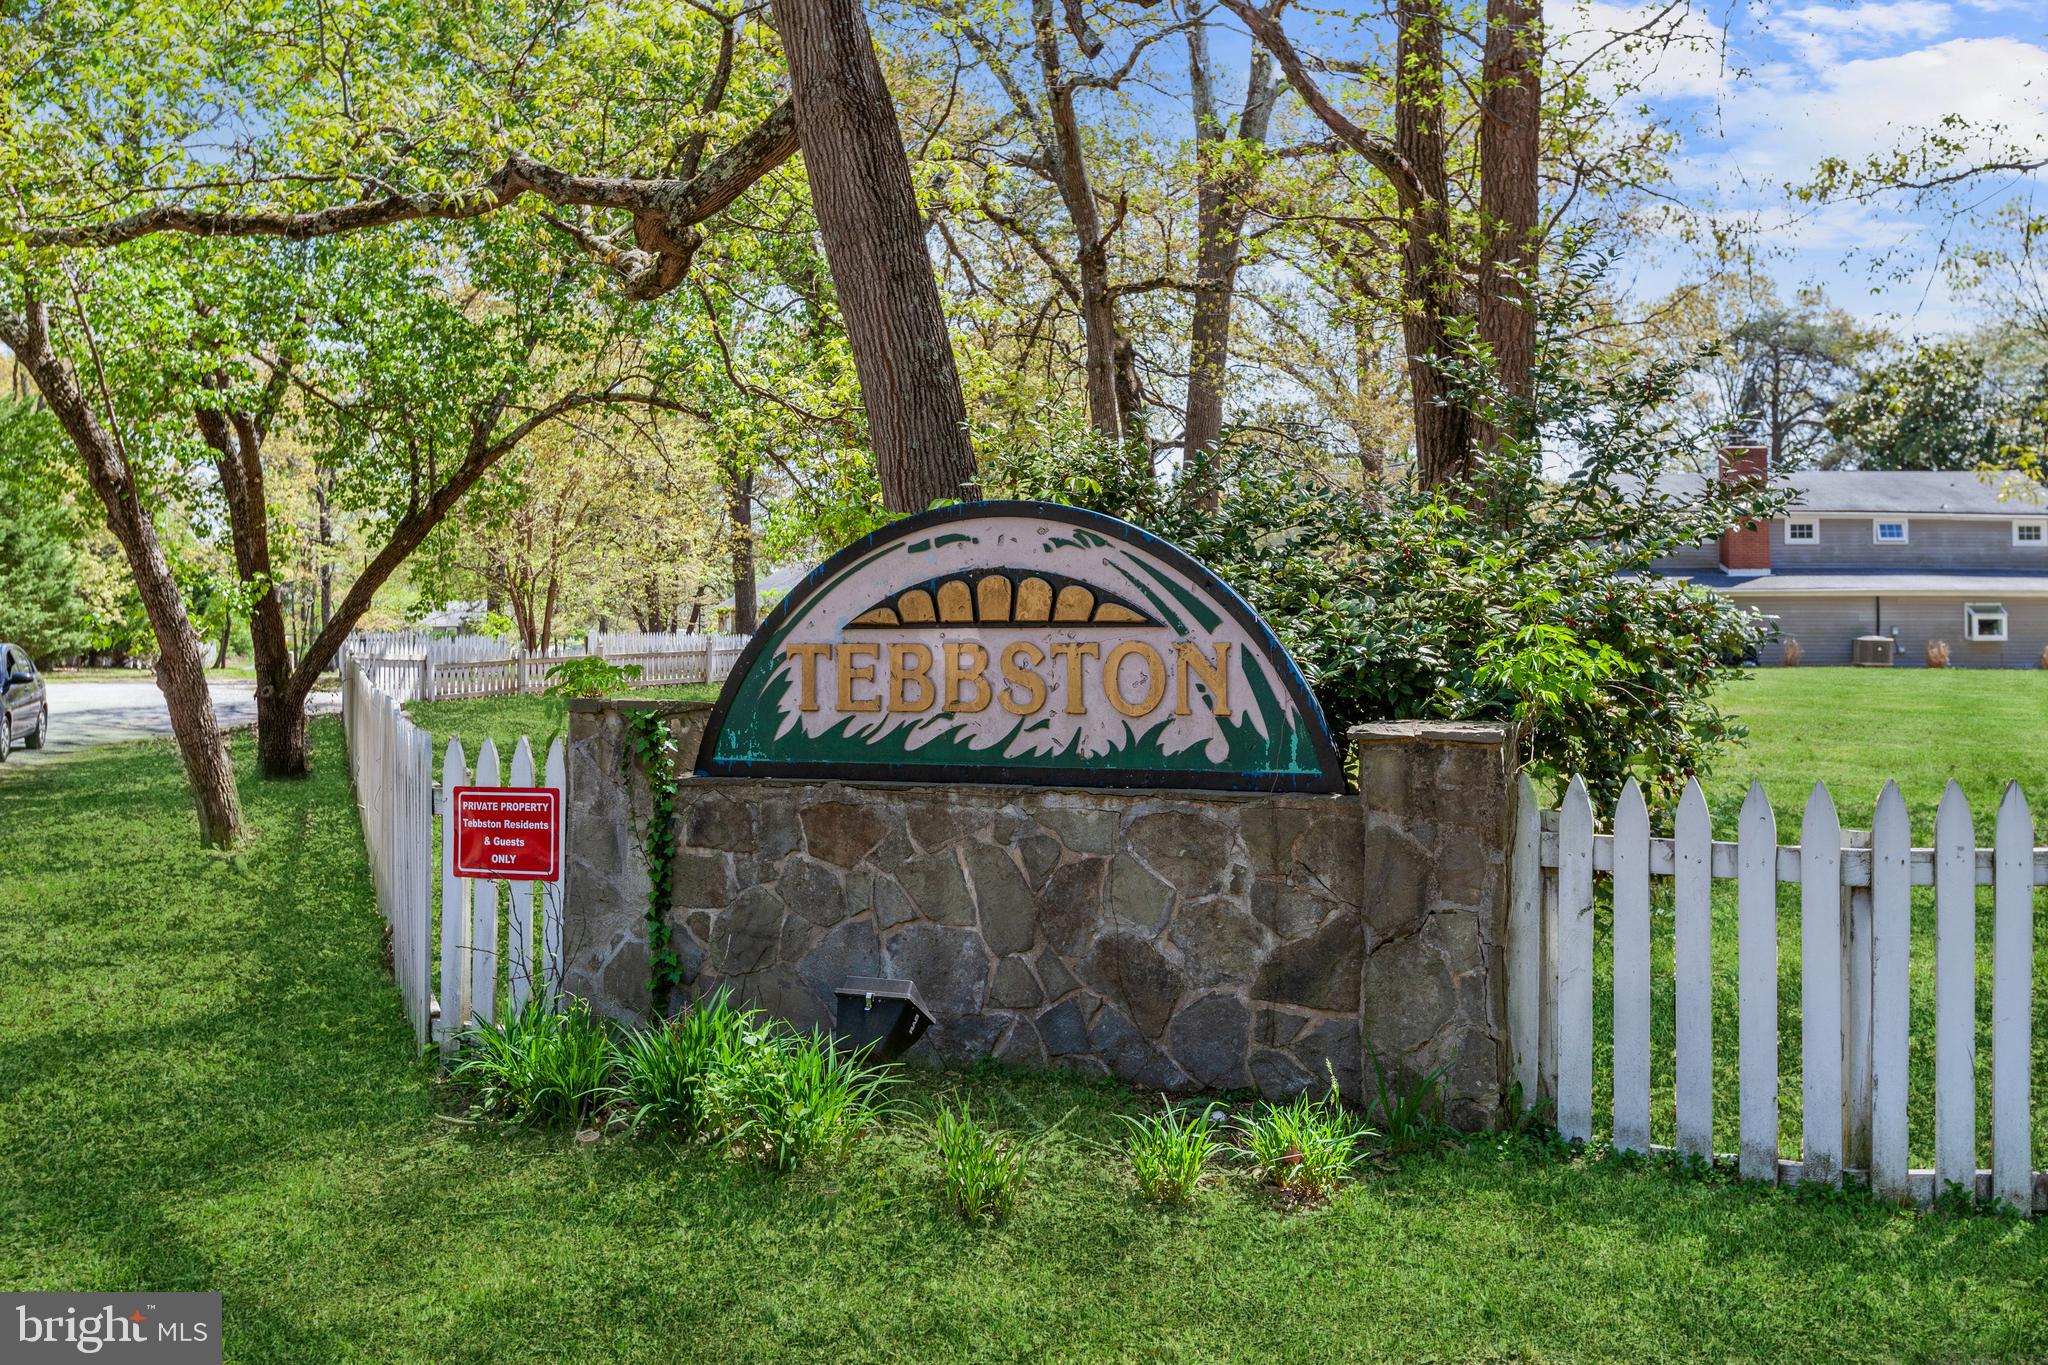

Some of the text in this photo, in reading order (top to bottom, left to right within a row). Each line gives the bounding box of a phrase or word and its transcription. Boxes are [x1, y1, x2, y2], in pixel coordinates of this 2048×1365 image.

[786, 641, 1234, 717] TEBBSTON
[463, 801, 549, 812] PRIVATE PROPERTY
[463, 818, 549, 830] Tebbston Residents
[484, 836, 525, 847] & Guests
[491, 854, 516, 864] ONLY
